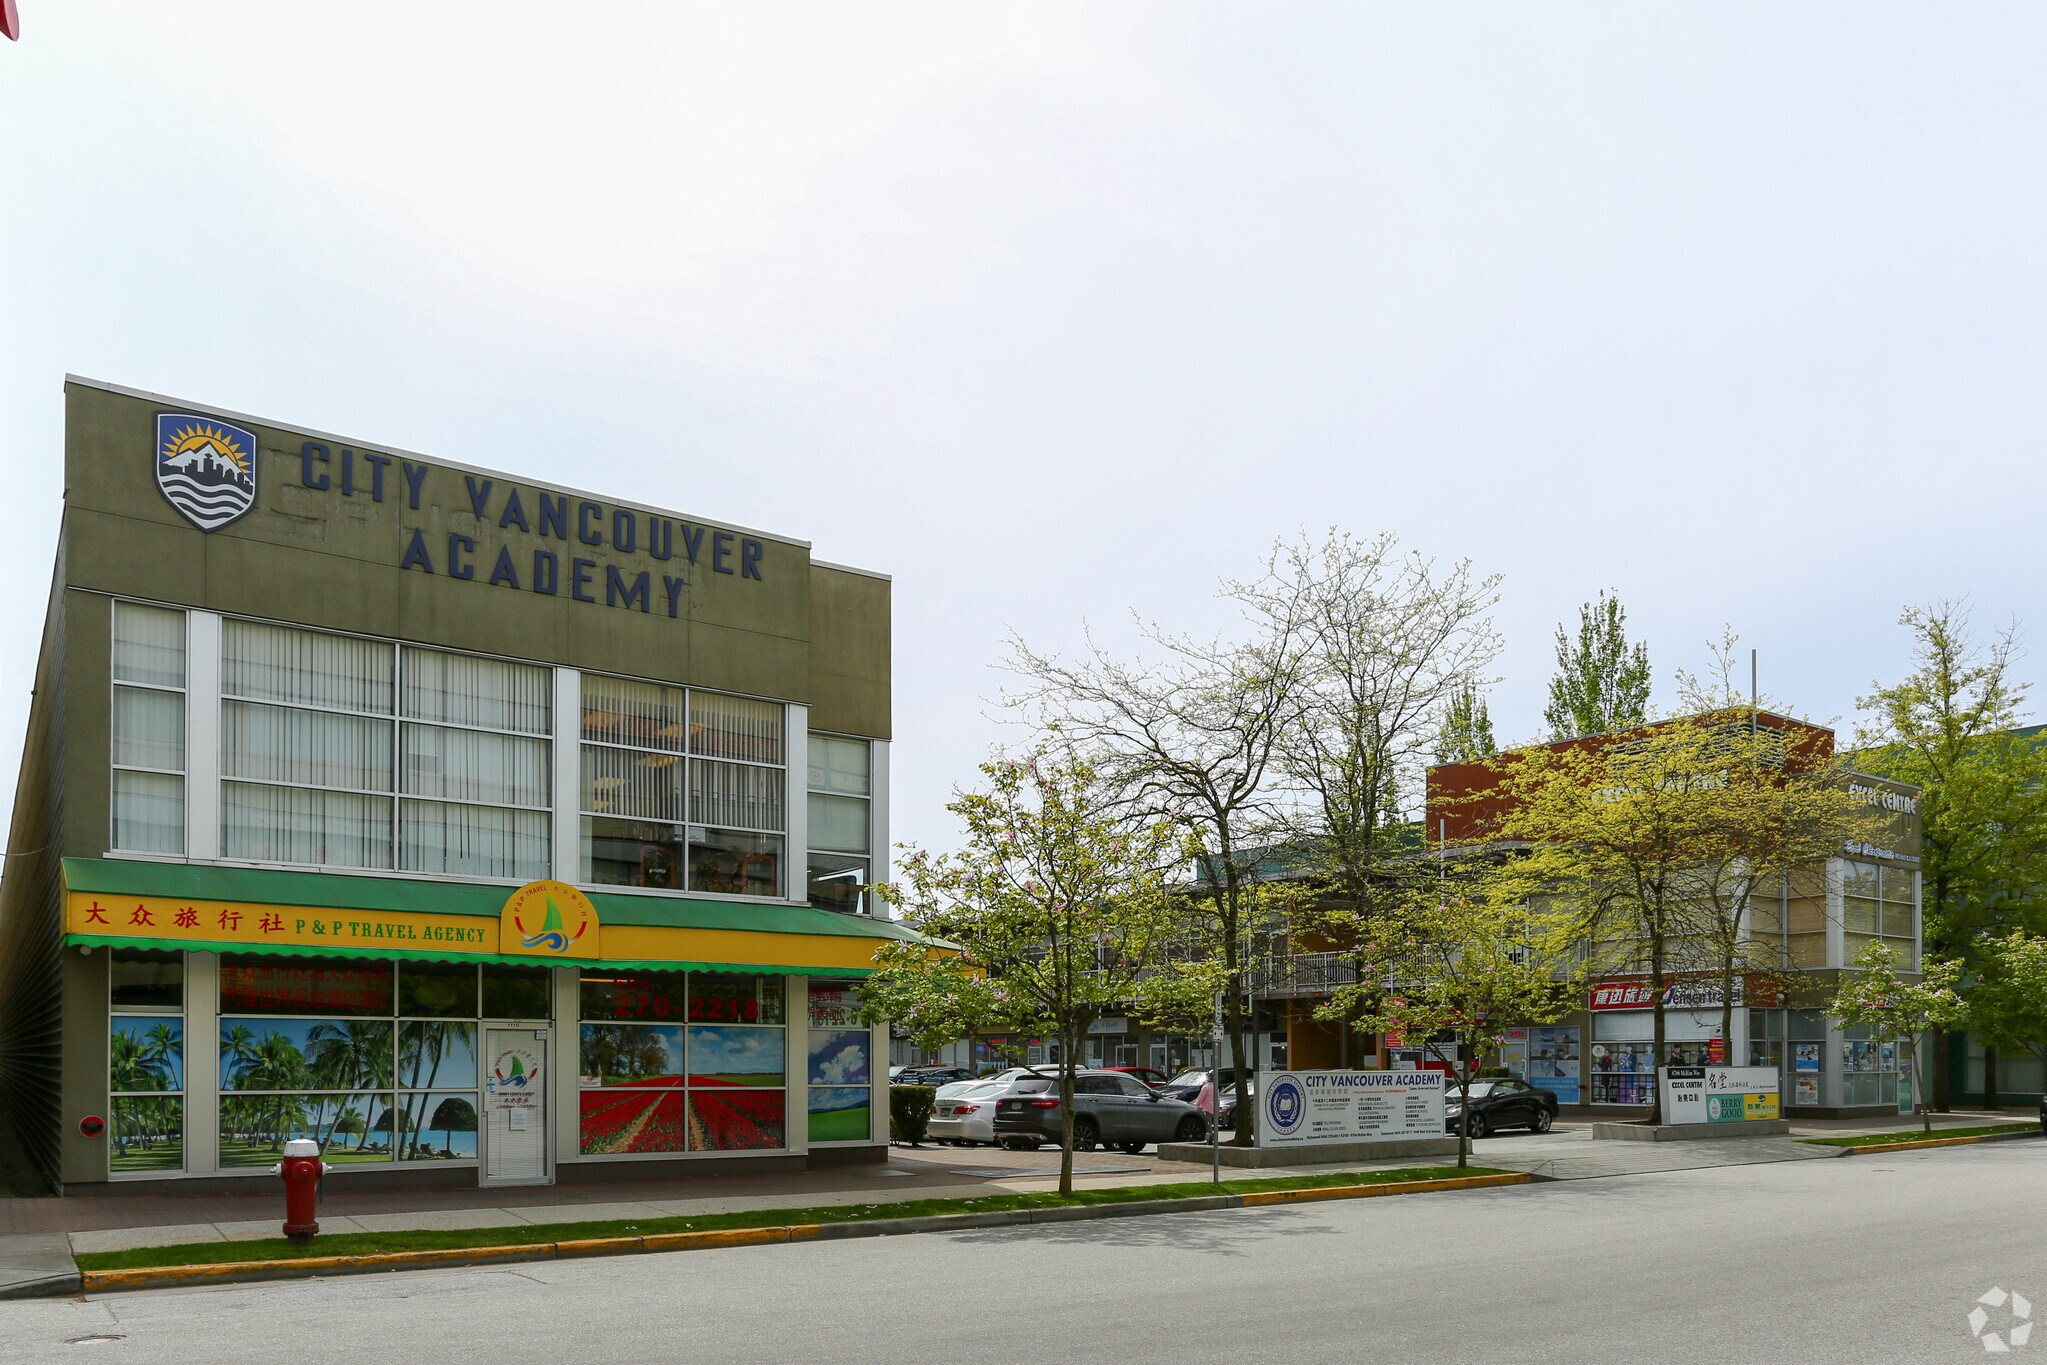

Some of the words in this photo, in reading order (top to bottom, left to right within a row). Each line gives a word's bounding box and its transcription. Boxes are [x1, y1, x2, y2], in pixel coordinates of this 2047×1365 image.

[302, 442, 428, 510] CITY
[465, 476, 763, 581] VANCOUVER
[401, 527, 684, 618] ACADEMY
[1882, 792, 1916, 814] CENTRE
[525, 885, 548, 897] TRAVEL
[85, 901, 286, 934] 大众旅行社
[296, 919, 306, 935] P
[312, 919, 326, 935] &
[333, 921, 343, 936] P
[349, 922, 417, 940] TRAVEL
[422, 925, 486, 943] AGENCY
[614, 994, 759, 1020] 270-2218
[1306, 1075, 1328, 1087] CITY
[1331, 1075, 1393, 1087] VANCOUVER
[1396, 1074, 1441, 1086] ACADEMY
[1721, 1099, 1742, 1109] BERRY
[1721, 1108, 1742, 1118] GOOD
